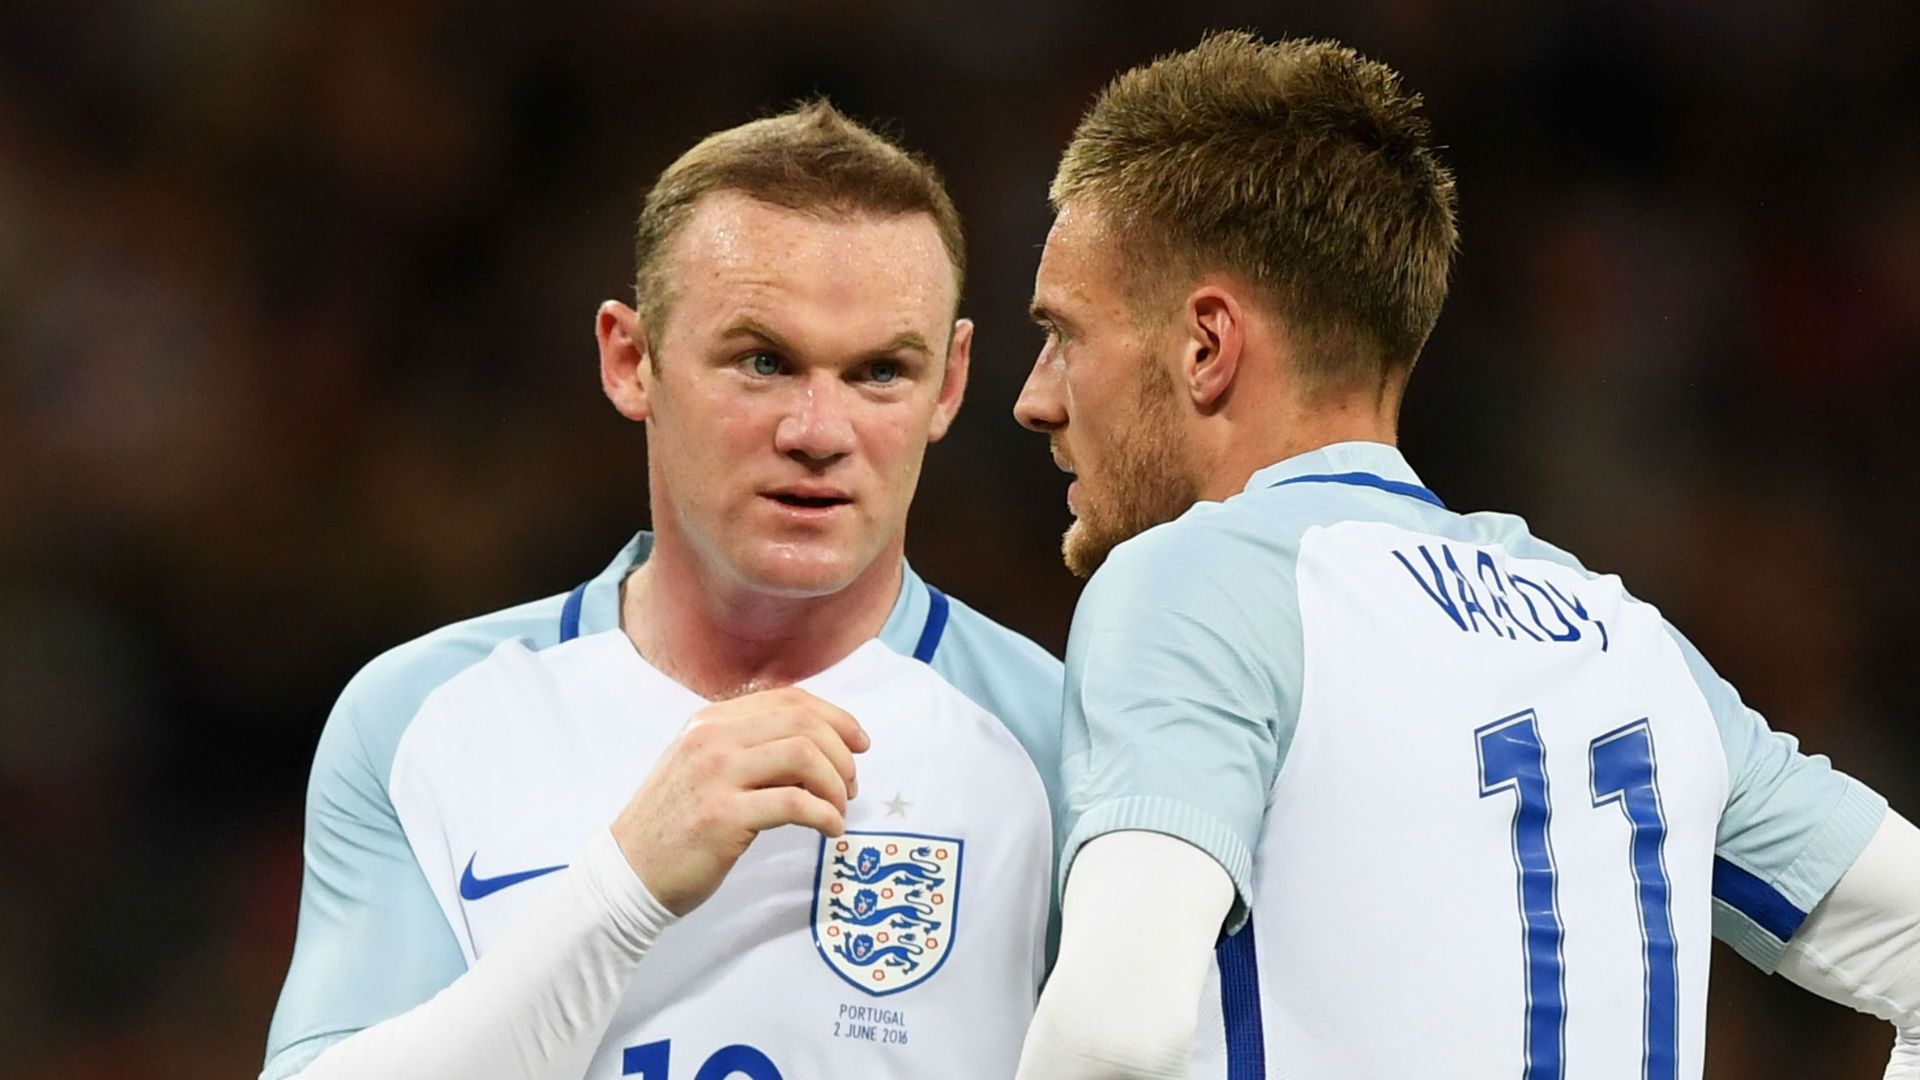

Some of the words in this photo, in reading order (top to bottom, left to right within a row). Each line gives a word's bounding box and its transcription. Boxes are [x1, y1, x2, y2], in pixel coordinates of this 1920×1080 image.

[1391, 544, 1609, 652] VARDY
[1474, 707, 1680, 1080] 11
[833, 1022, 841, 1037] 2
[845, 1024, 877, 1042] JUNE
[882, 1028, 908, 1045] 2016
[839, 1003, 905, 1027] PORTUGAL
